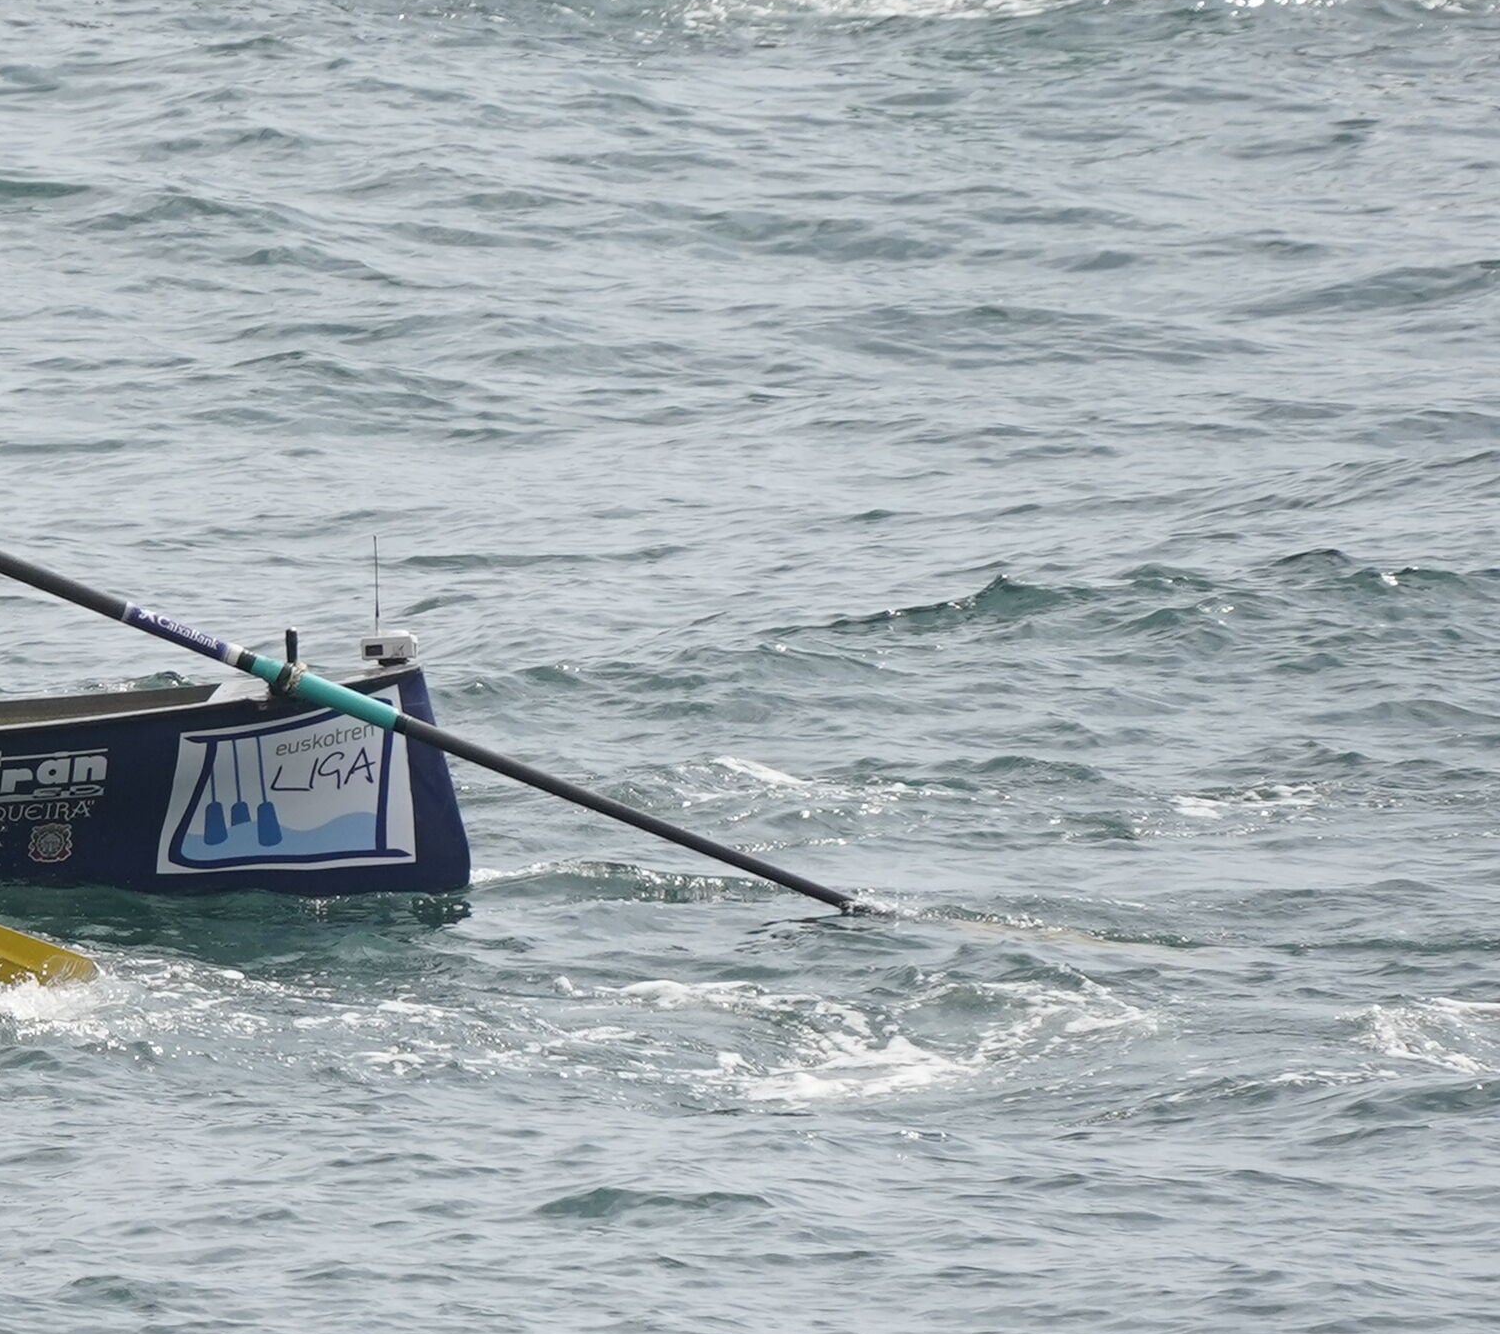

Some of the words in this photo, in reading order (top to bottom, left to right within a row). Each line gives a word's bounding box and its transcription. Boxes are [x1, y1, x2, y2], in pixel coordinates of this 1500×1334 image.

[157, 615, 219, 651] CaixaBank
[275, 723, 376, 758] euskotren
[269, 747, 376, 792] LIGA
